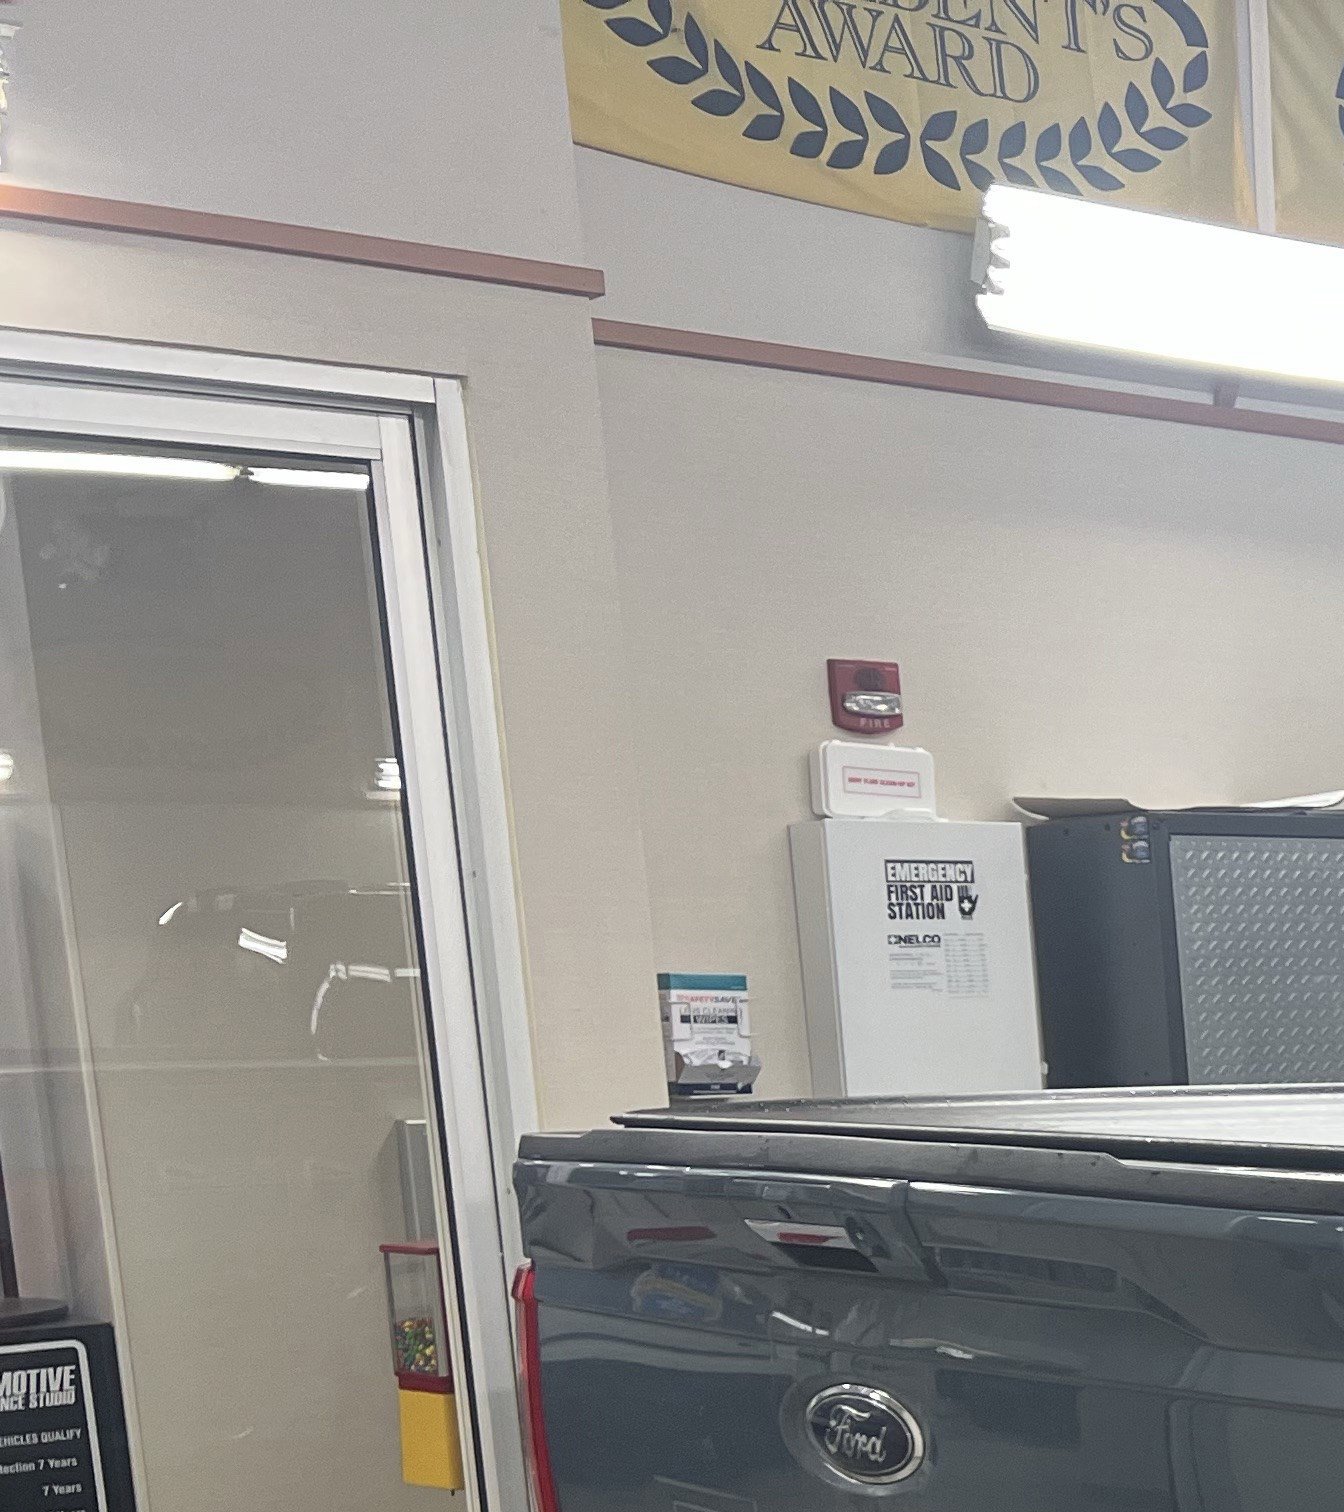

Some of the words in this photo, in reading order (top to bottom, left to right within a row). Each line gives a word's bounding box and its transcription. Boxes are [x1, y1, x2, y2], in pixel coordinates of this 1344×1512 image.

[756, 0, 1040, 102] AWARD
[886, 862, 974, 881] EMERGENCY
[887, 885, 925, 901] FIRST
[930, 885, 953, 901] AID
[887, 902, 945, 920] STATION
[899, 934, 941, 945] NELCO
[28, 1388, 75, 1409] STUDIO
[41, 1428, 81, 1443] QUALIFY
[825, 1404, 888, 1463] Ford
[38, 1458, 45, 1471] 7
[48, 1457, 77, 1469] Years
[42, 1485, 49, 1496] 7
[52, 1483, 82, 1495] Years
